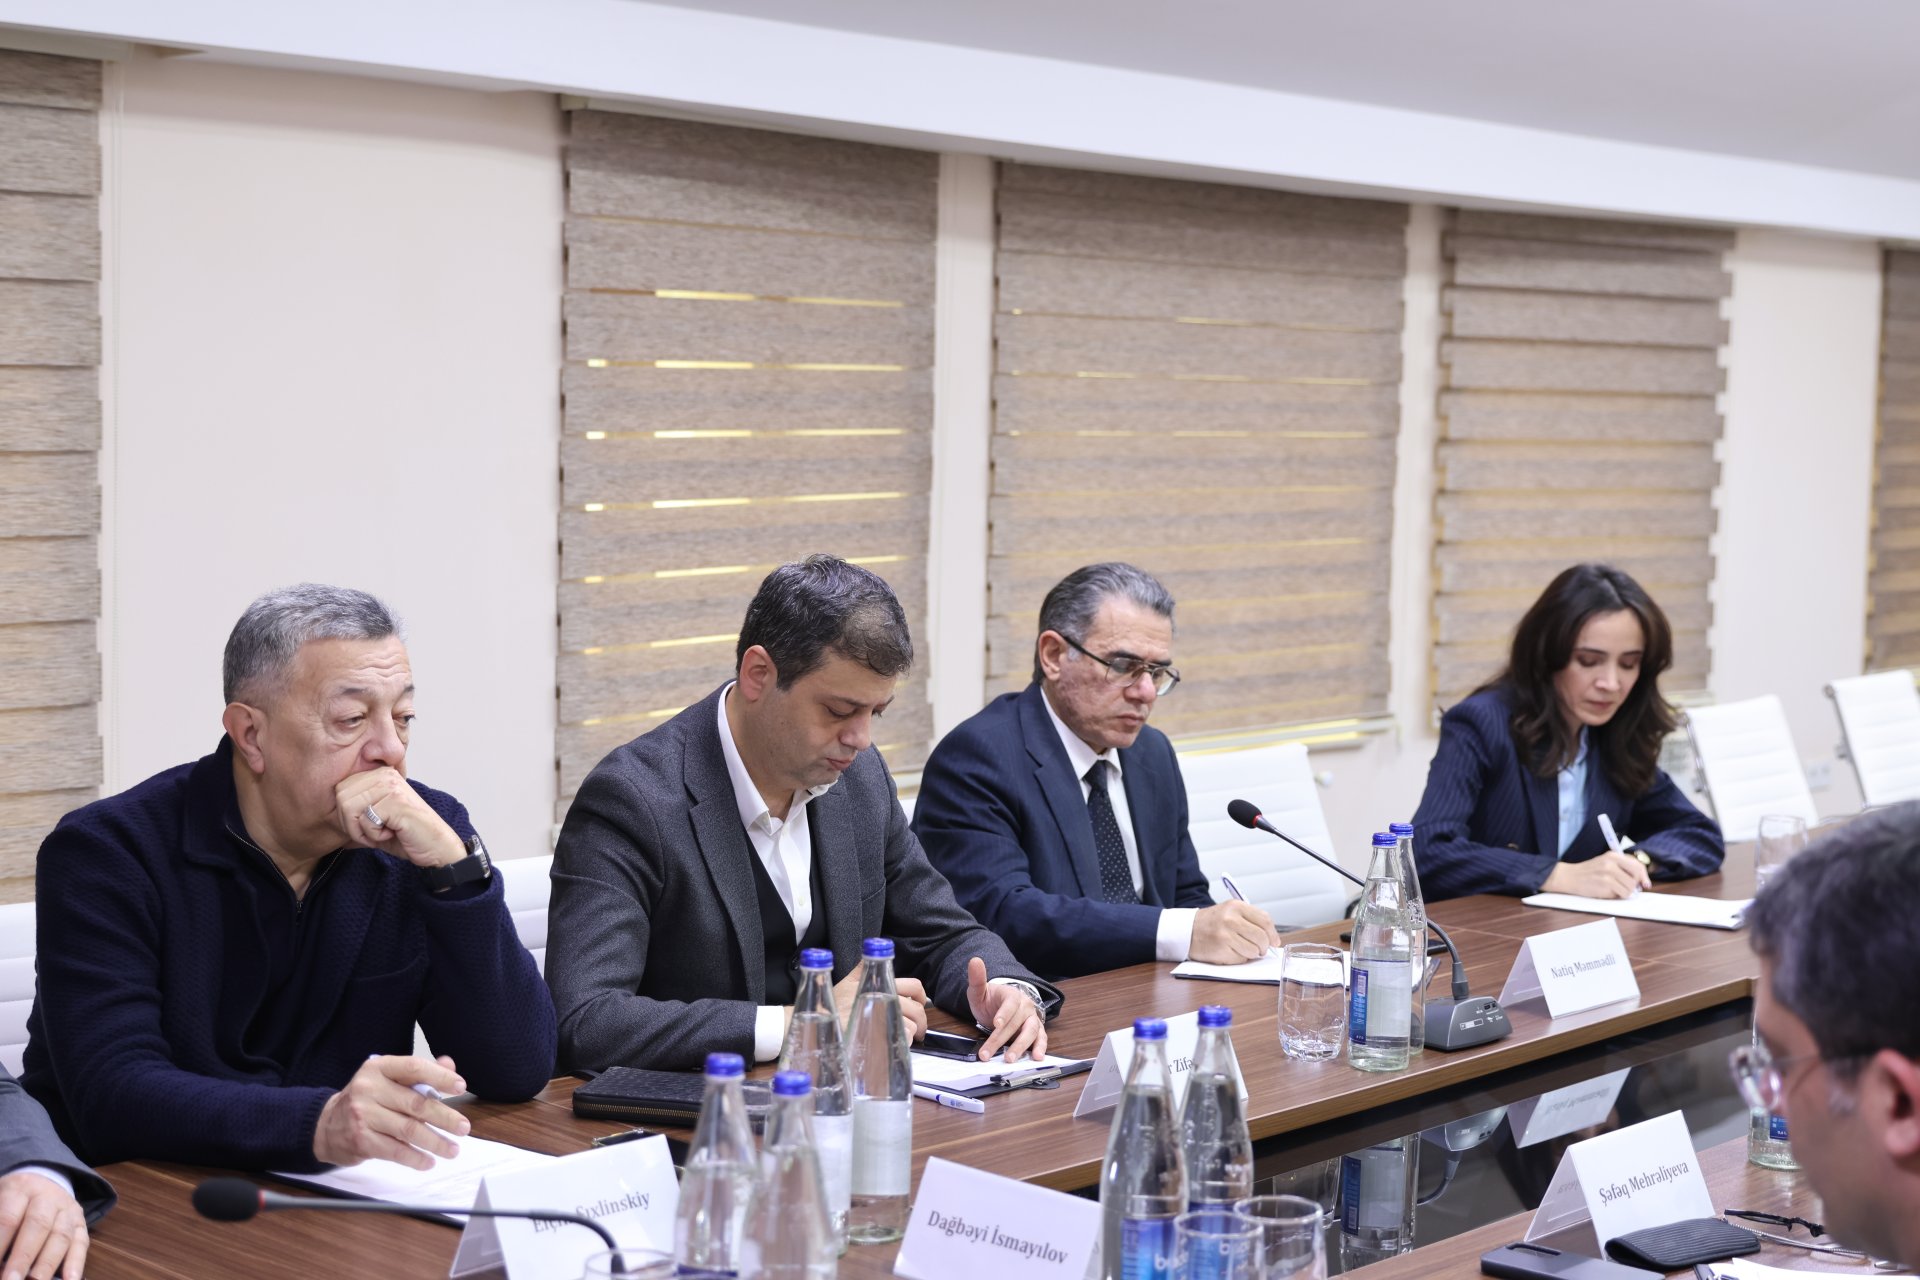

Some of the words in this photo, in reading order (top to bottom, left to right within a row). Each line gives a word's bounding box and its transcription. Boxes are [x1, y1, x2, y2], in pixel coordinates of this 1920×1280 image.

[1550, 963, 1576, 979] Natiq
[1573, 953, 1616, 974] Məmmədli
[1599, 1183, 1631, 1208] Şəfəq
[1628, 1162, 1690, 1193] Mehrəliyeva
[927, 1210, 990, 1243] Dağbəyi
[990, 1224, 1069, 1264] İsmayılov
